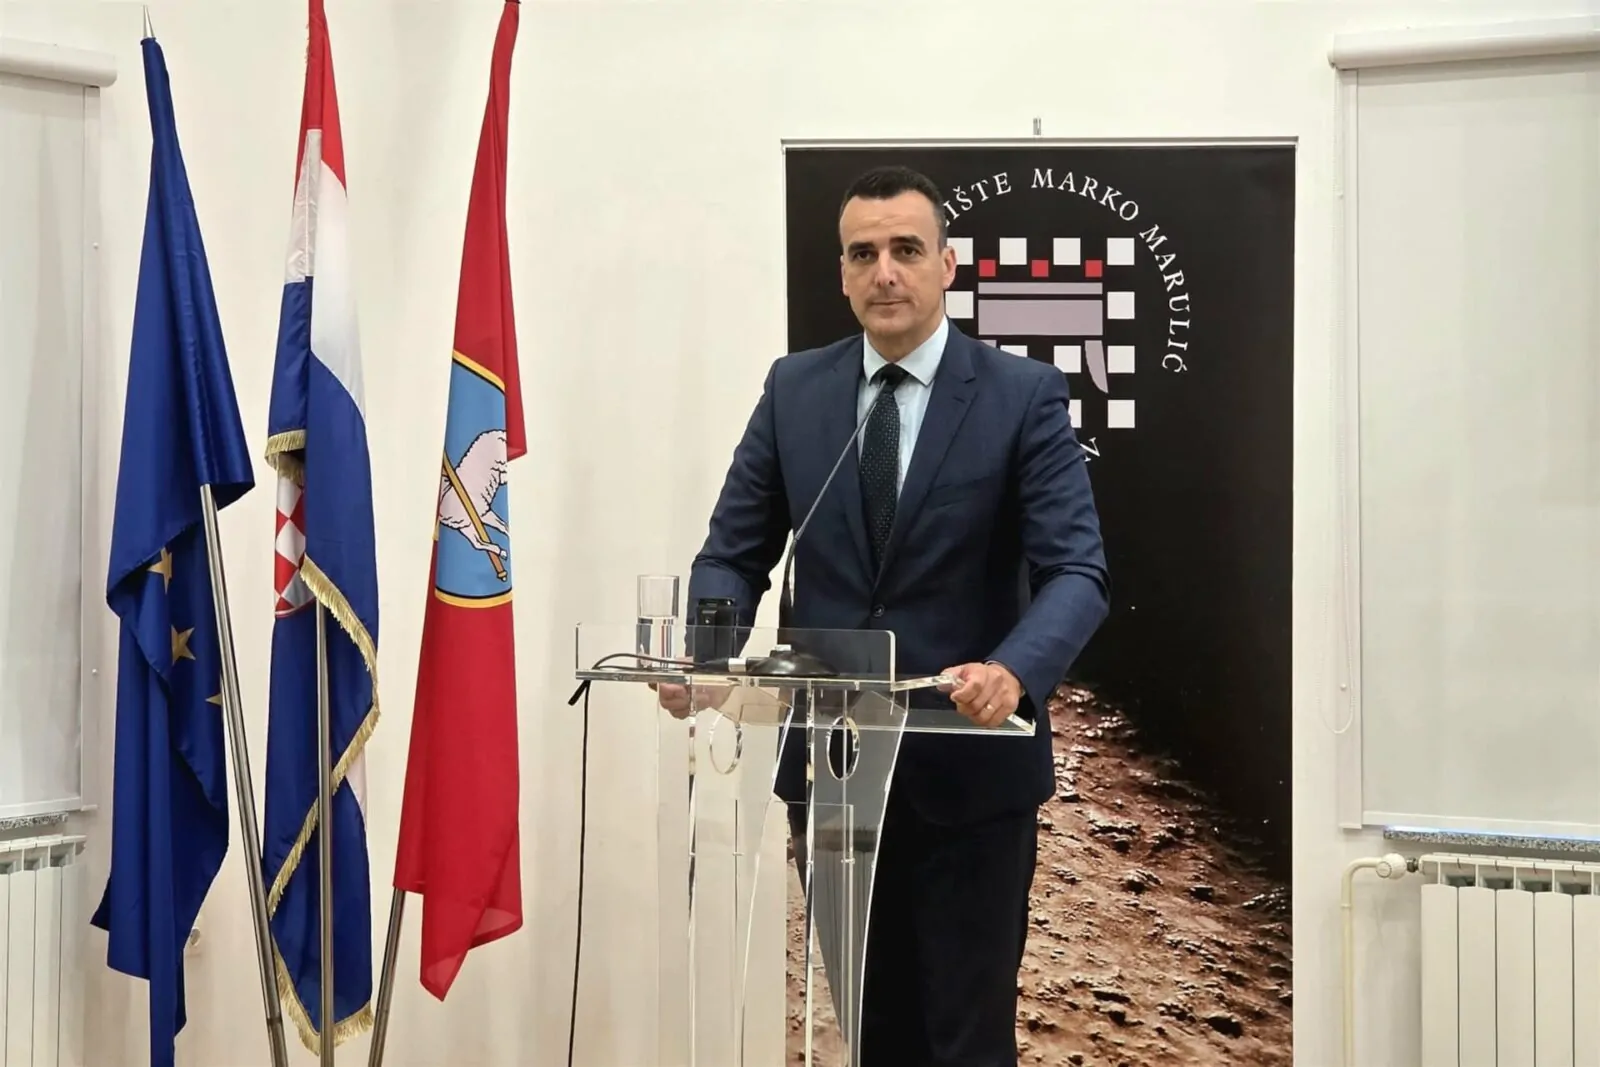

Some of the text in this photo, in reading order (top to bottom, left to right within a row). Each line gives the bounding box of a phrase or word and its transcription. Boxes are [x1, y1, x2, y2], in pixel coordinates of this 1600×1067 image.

[943, 167, 1191, 373] IŠTE MARKO MARULIĆ
